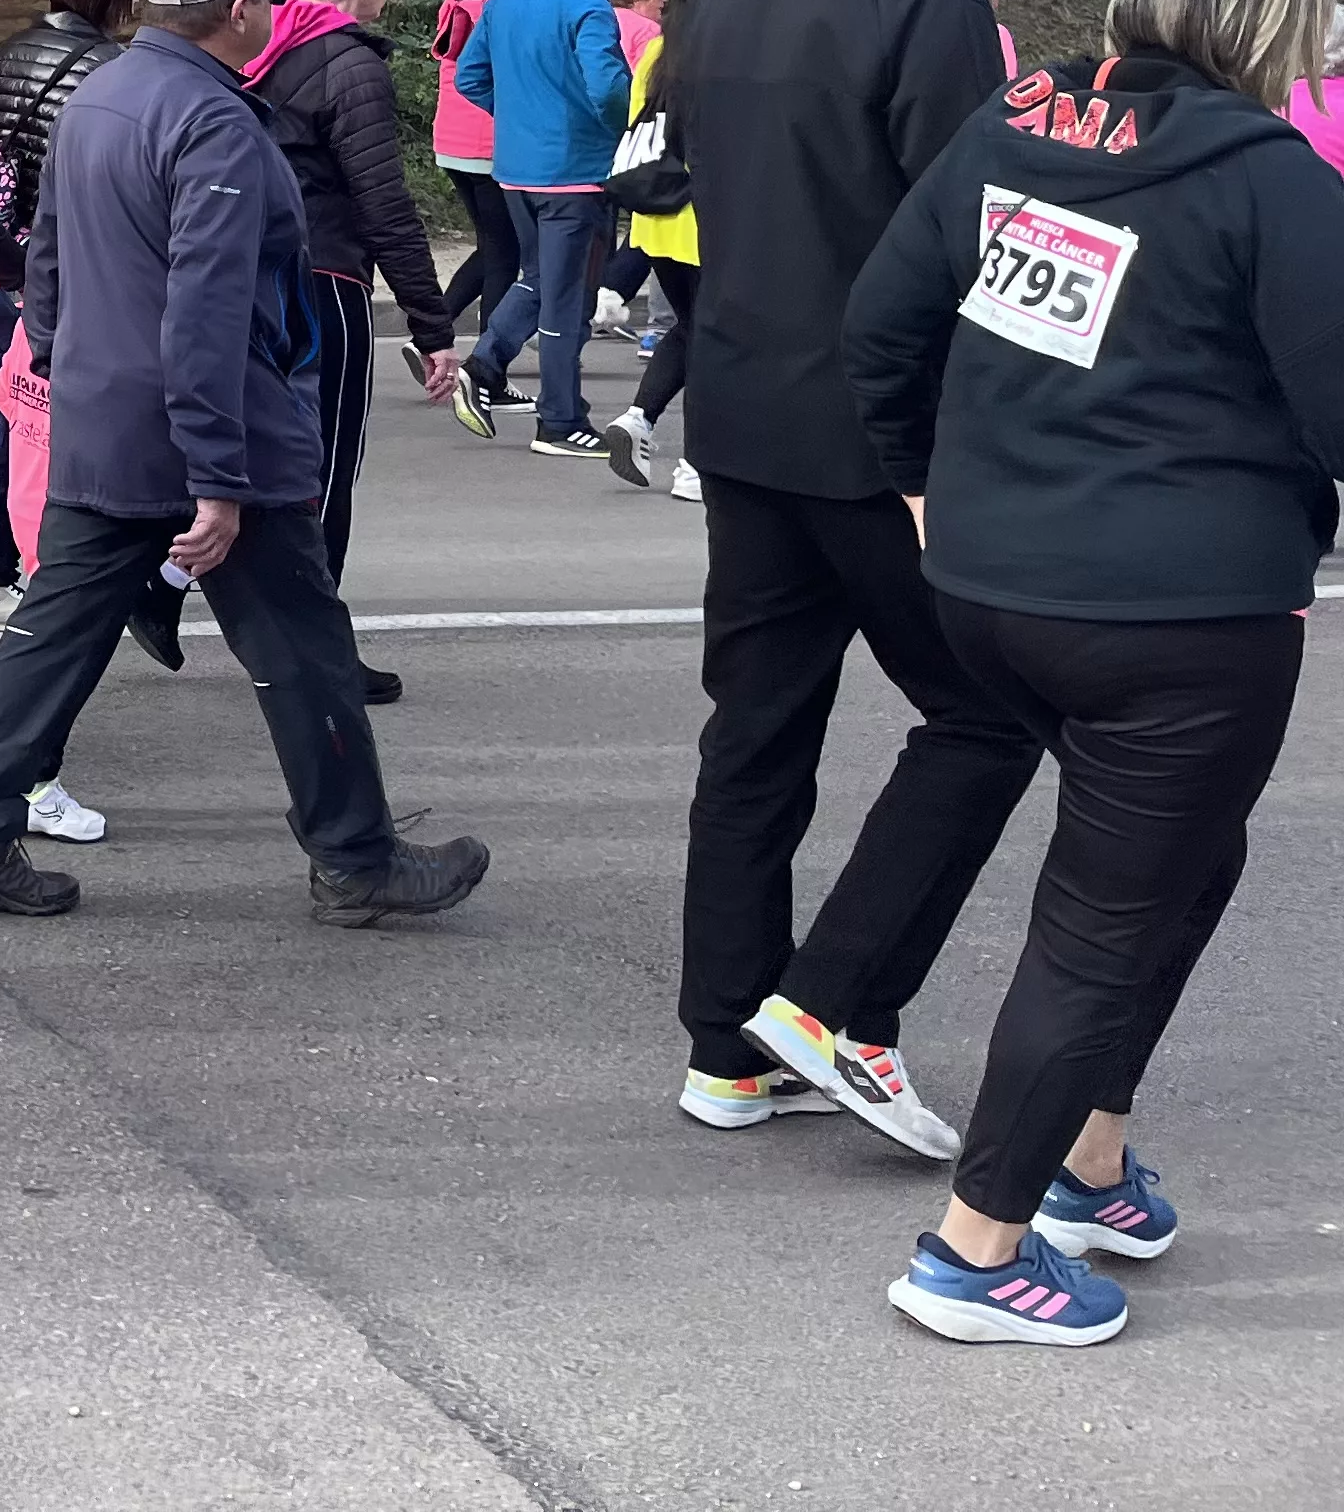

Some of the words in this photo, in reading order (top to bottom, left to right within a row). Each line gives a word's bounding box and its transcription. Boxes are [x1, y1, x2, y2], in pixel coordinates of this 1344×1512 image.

[991, 217, 1034, 242] CNTRA
[1034, 232, 1049, 248] EL
[1050, 238, 1105, 269] CÁNCER
[1030, 217, 1065, 237] HUESCA
[984, 239, 1095, 323] 3795
